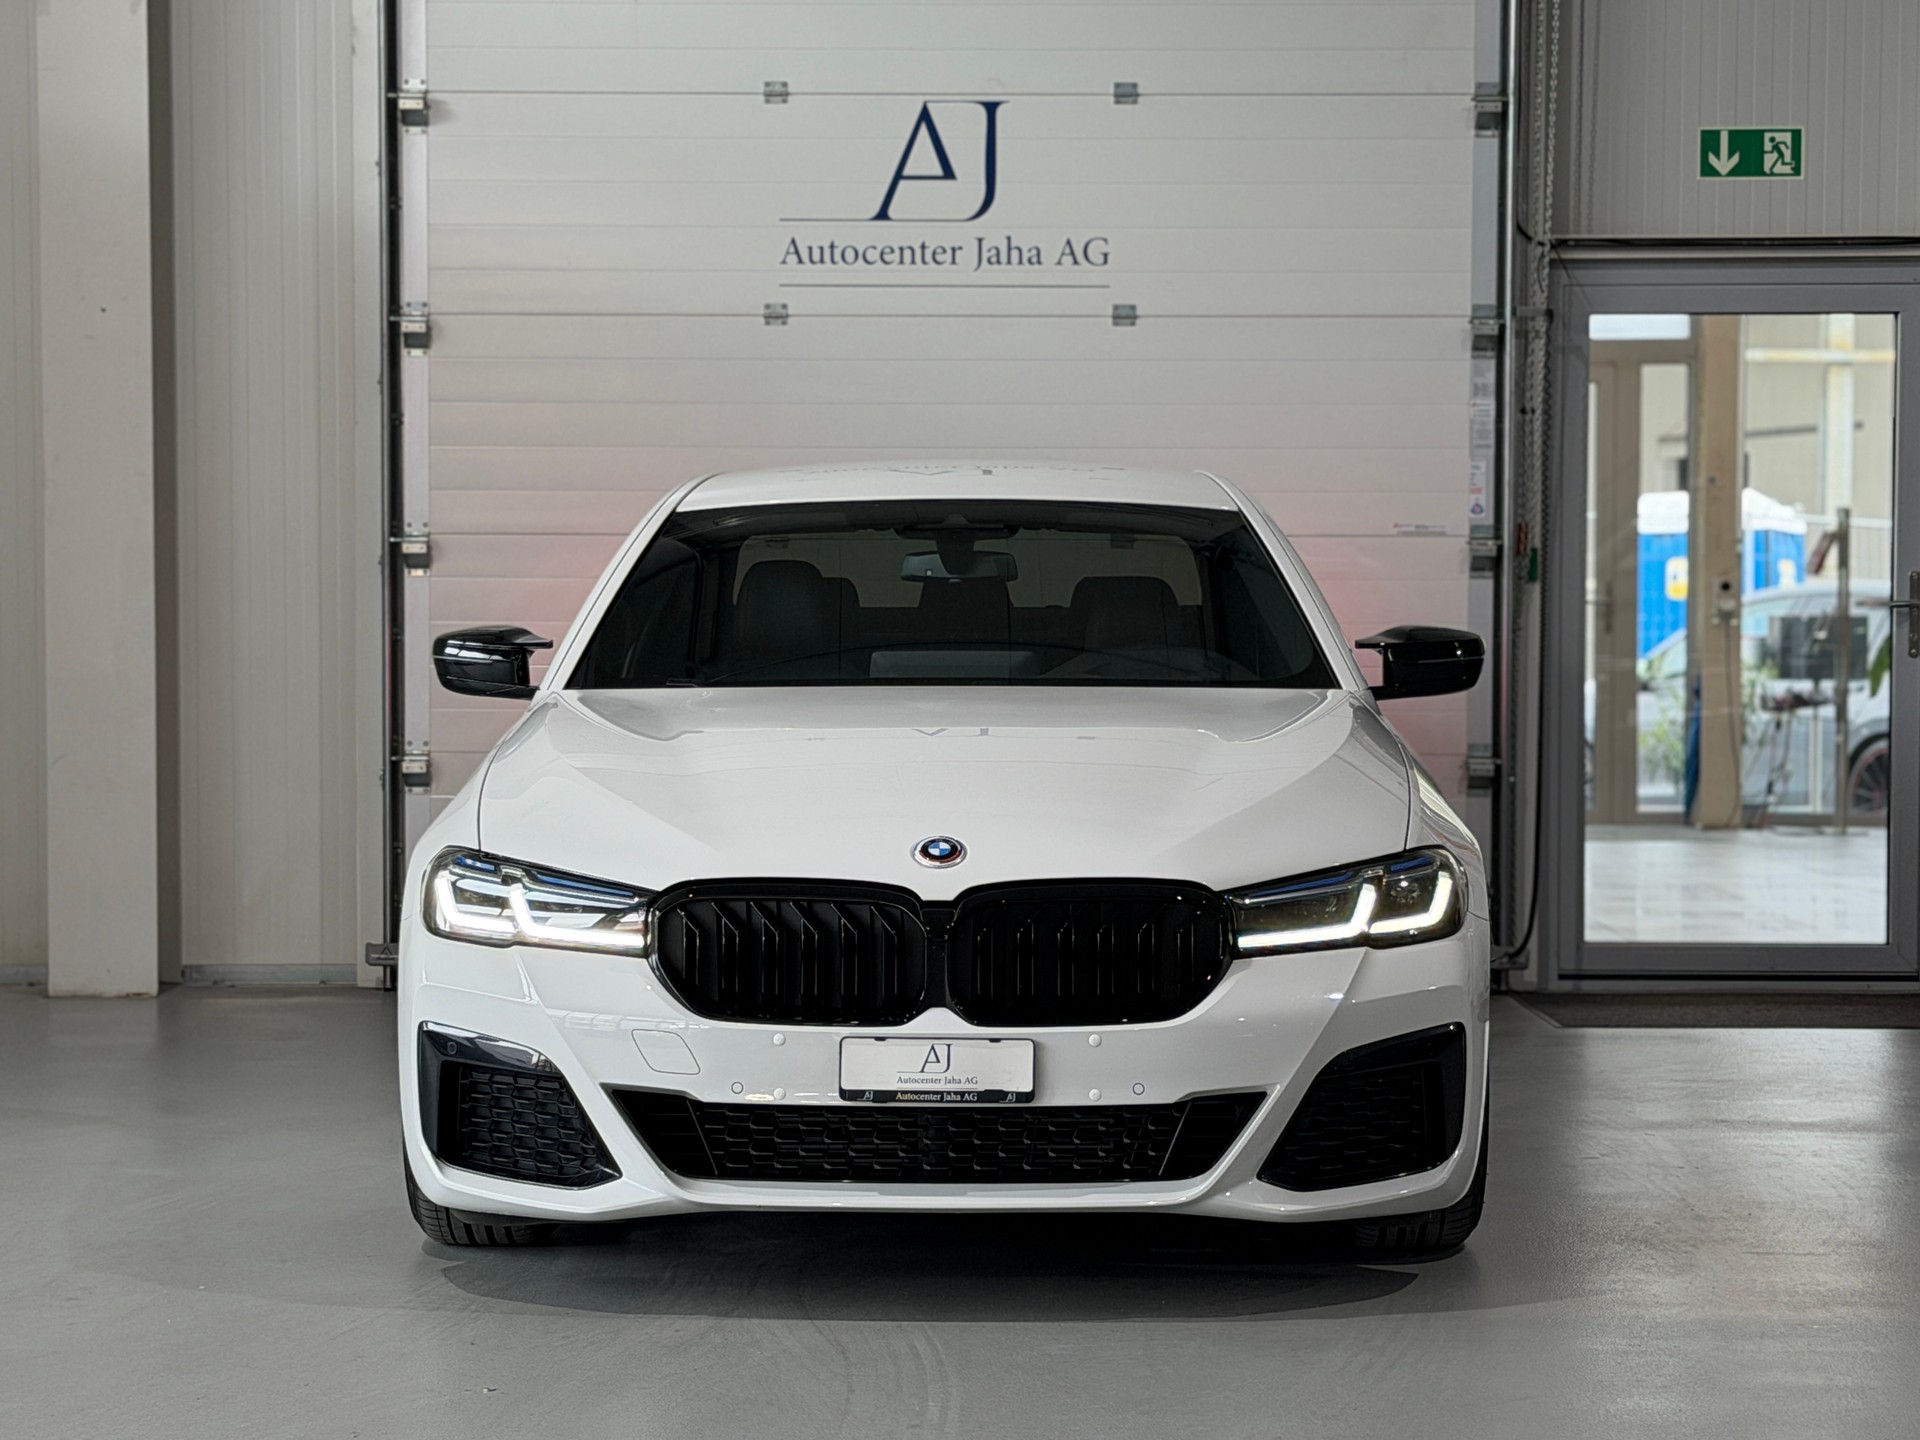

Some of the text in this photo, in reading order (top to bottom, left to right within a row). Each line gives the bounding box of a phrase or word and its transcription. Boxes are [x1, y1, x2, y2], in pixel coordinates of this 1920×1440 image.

[868, 100, 1010, 222] AJ
[779, 235, 1111, 272] Autocenter Jaha AG
[919, 1043, 953, 1074] AJ
[896, 1075, 979, 1086] Autocenter Jaha AG
[895, 1091, 978, 1102] Autocenter Jaha AG
